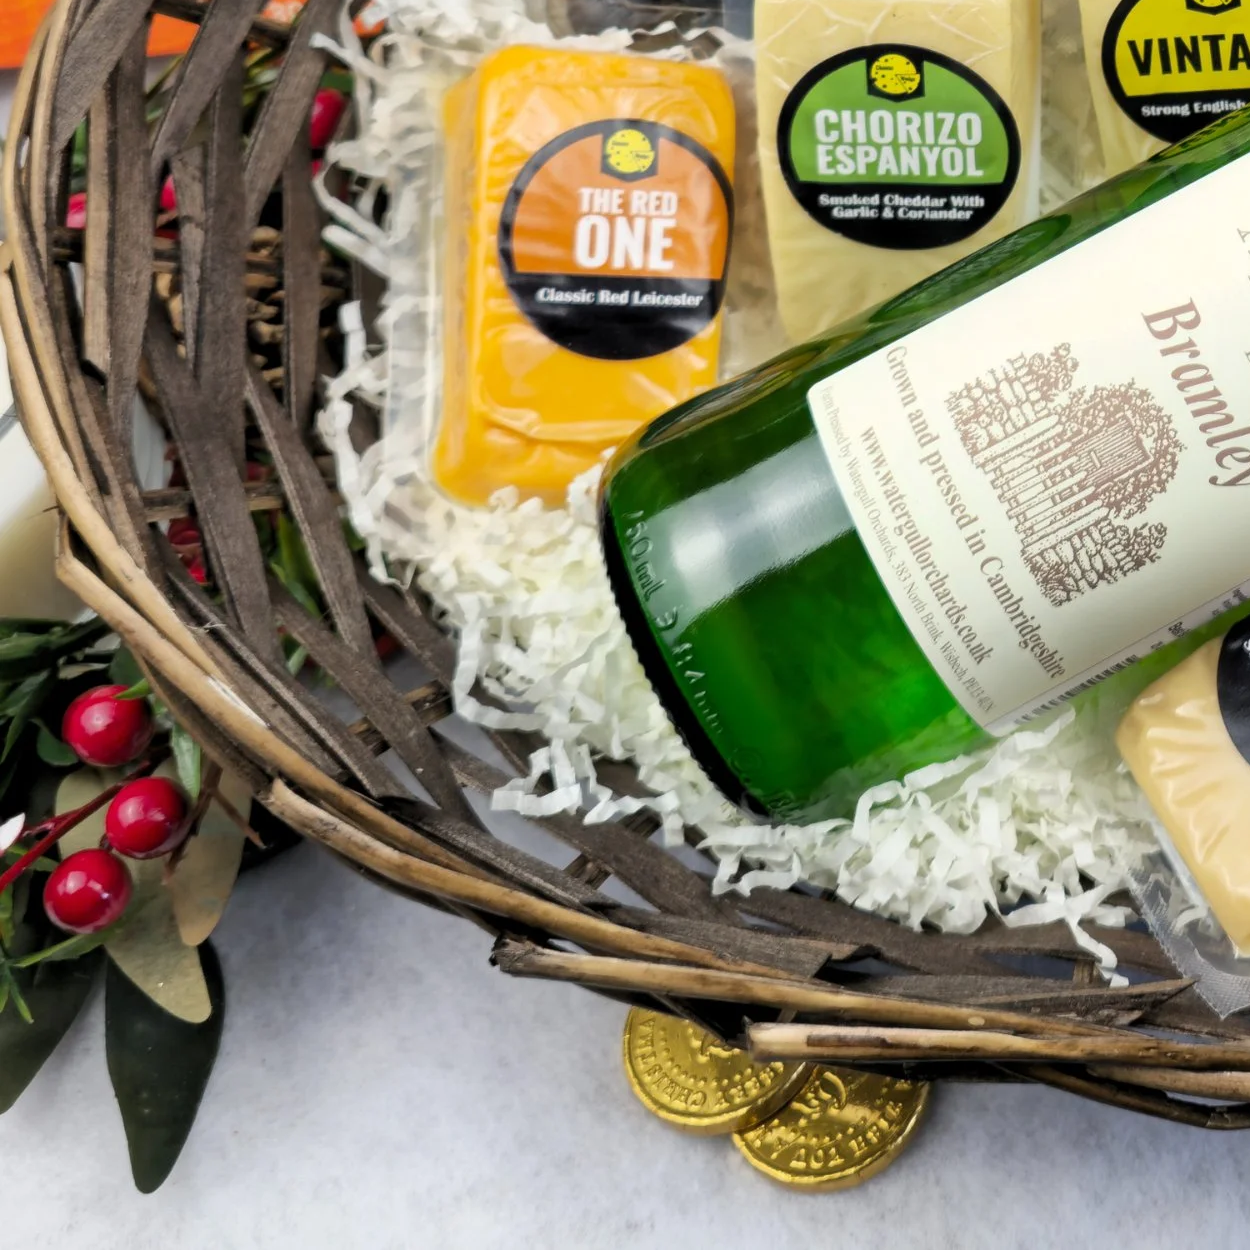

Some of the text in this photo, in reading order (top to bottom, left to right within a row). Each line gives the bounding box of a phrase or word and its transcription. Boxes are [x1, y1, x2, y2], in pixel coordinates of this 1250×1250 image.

[1141, 99, 1247, 118] Strong English
[814, 108, 983, 147] CHORIZO
[816, 143, 984, 177] ESPANYOL
[579, 186, 679, 217] THE RED
[819, 193, 985, 208] Smoked Cheddar With
[832, 206, 974, 221] Garlic & Coriander
[575, 214, 677, 271] ONE
[536, 287, 704, 308] Classic Red Leicester
[825, 409, 851, 443] Pressed
[842, 458, 876, 508] Watergull
[866, 508, 899, 561] Orchards,
[904, 582, 928, 612] North
[884, 345, 1068, 681] Grown and pressed in Cambridgeshire
[858, 425, 997, 667] www.watergullorchards.co.uk
